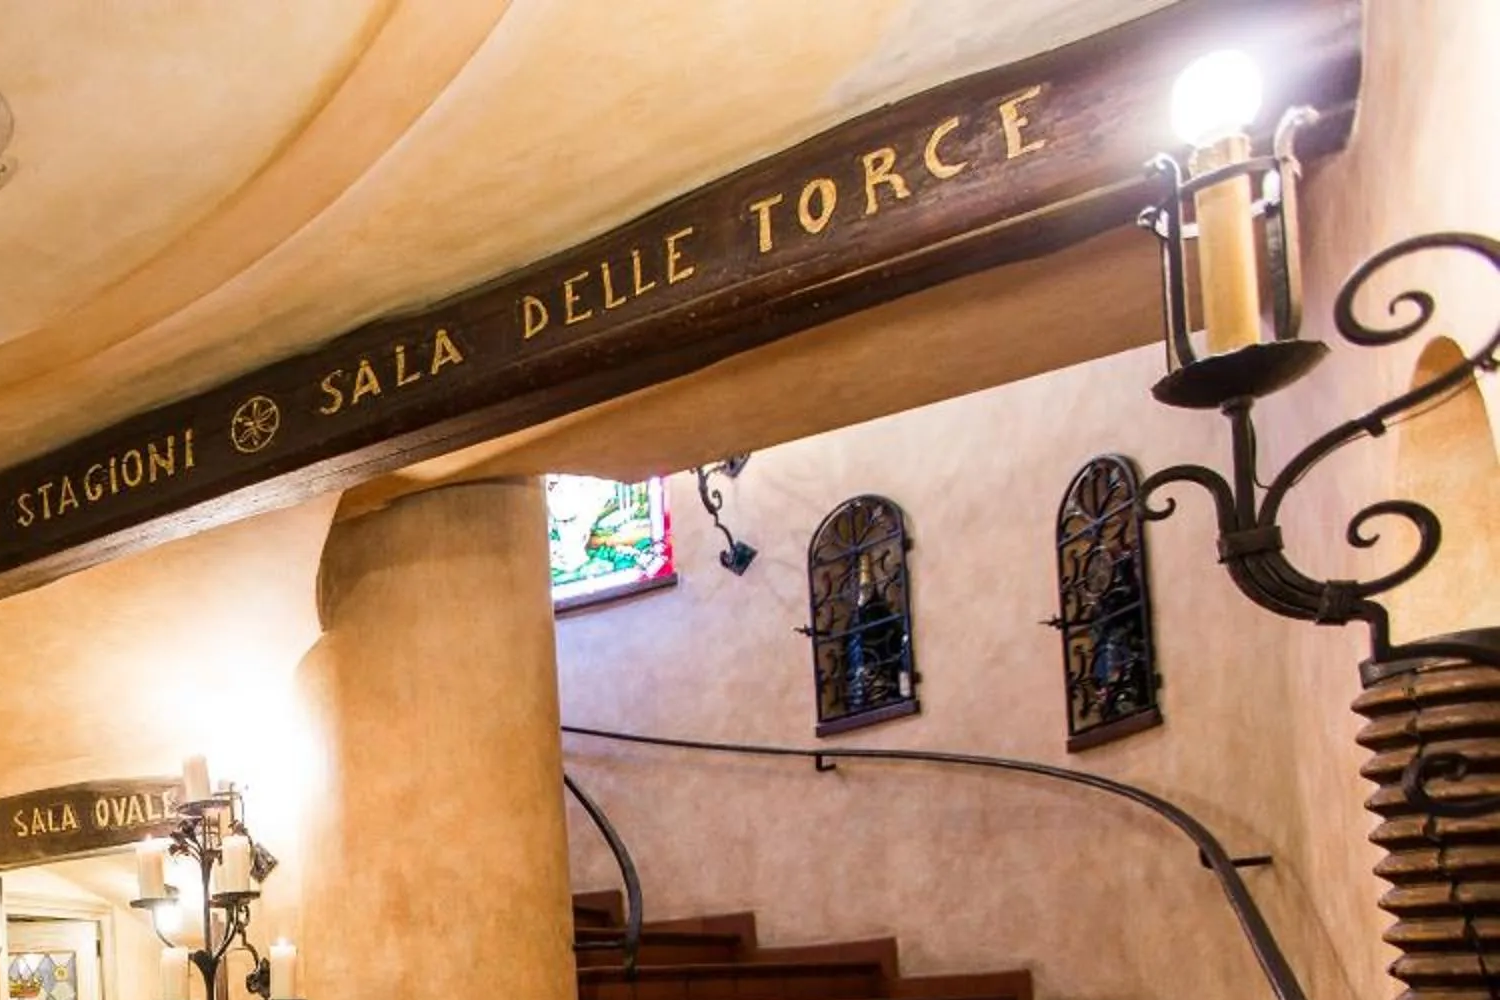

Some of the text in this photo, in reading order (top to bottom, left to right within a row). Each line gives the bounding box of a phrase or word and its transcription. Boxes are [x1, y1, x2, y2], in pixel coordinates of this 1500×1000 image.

[319, 85, 1048, 414] SALA DELLE TORCE
[16, 428, 196, 527] STAGIONI
[13, 790, 180, 837] SALA OVALE
